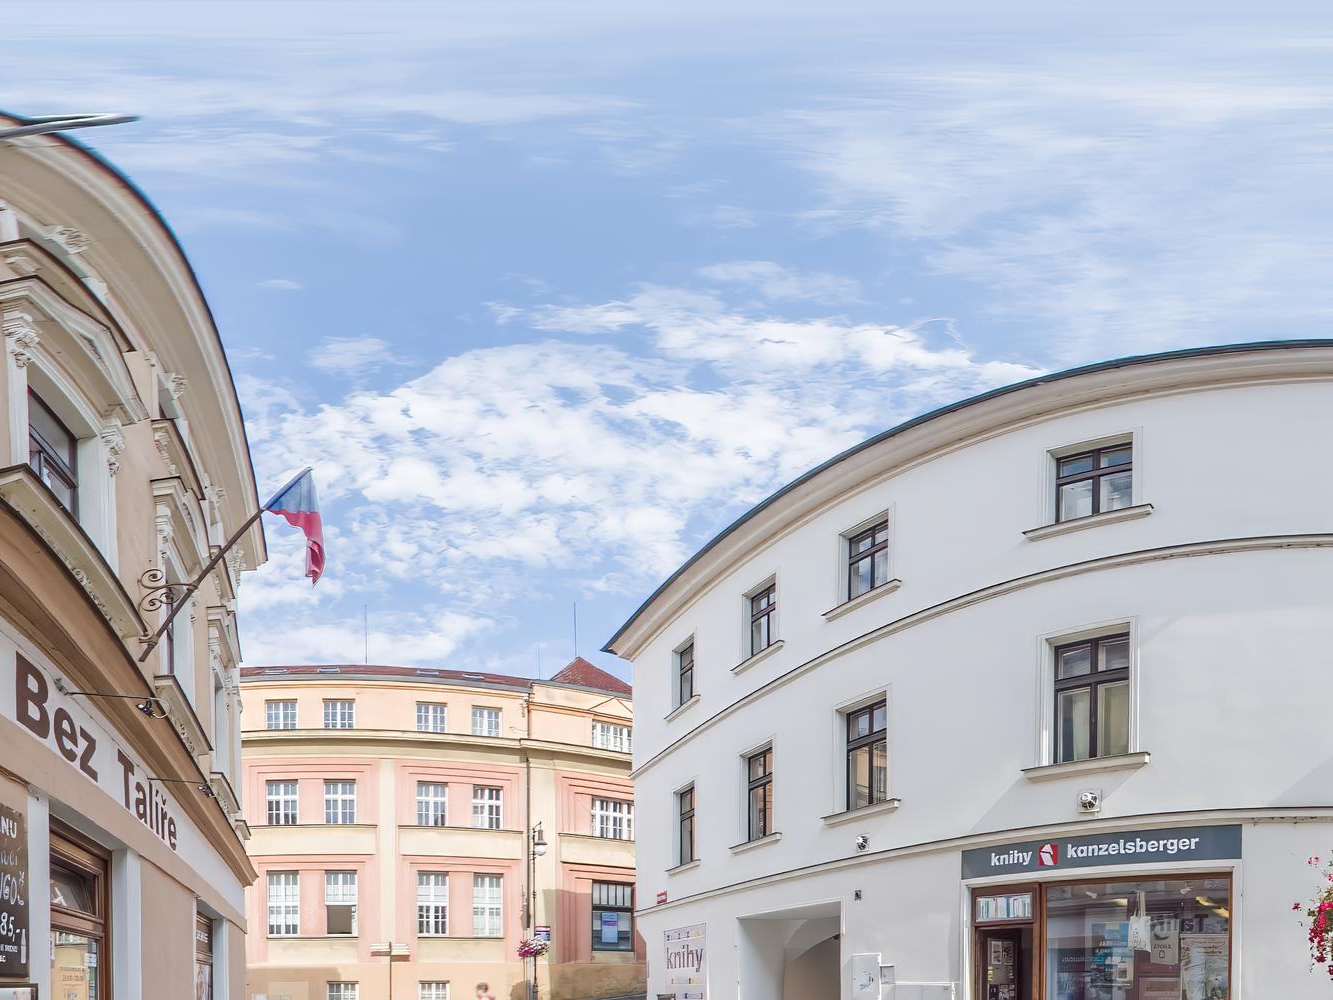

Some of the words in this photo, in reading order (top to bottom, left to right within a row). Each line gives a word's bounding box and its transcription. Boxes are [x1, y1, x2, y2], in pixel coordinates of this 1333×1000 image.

[15, 650, 99, 783] Bez
[117, 748, 178, 852] Talíře
[990, 850, 1032, 866] knihy
[1066, 837, 1200, 859] kanzelsberger
[666, 944, 704, 973] knihy
